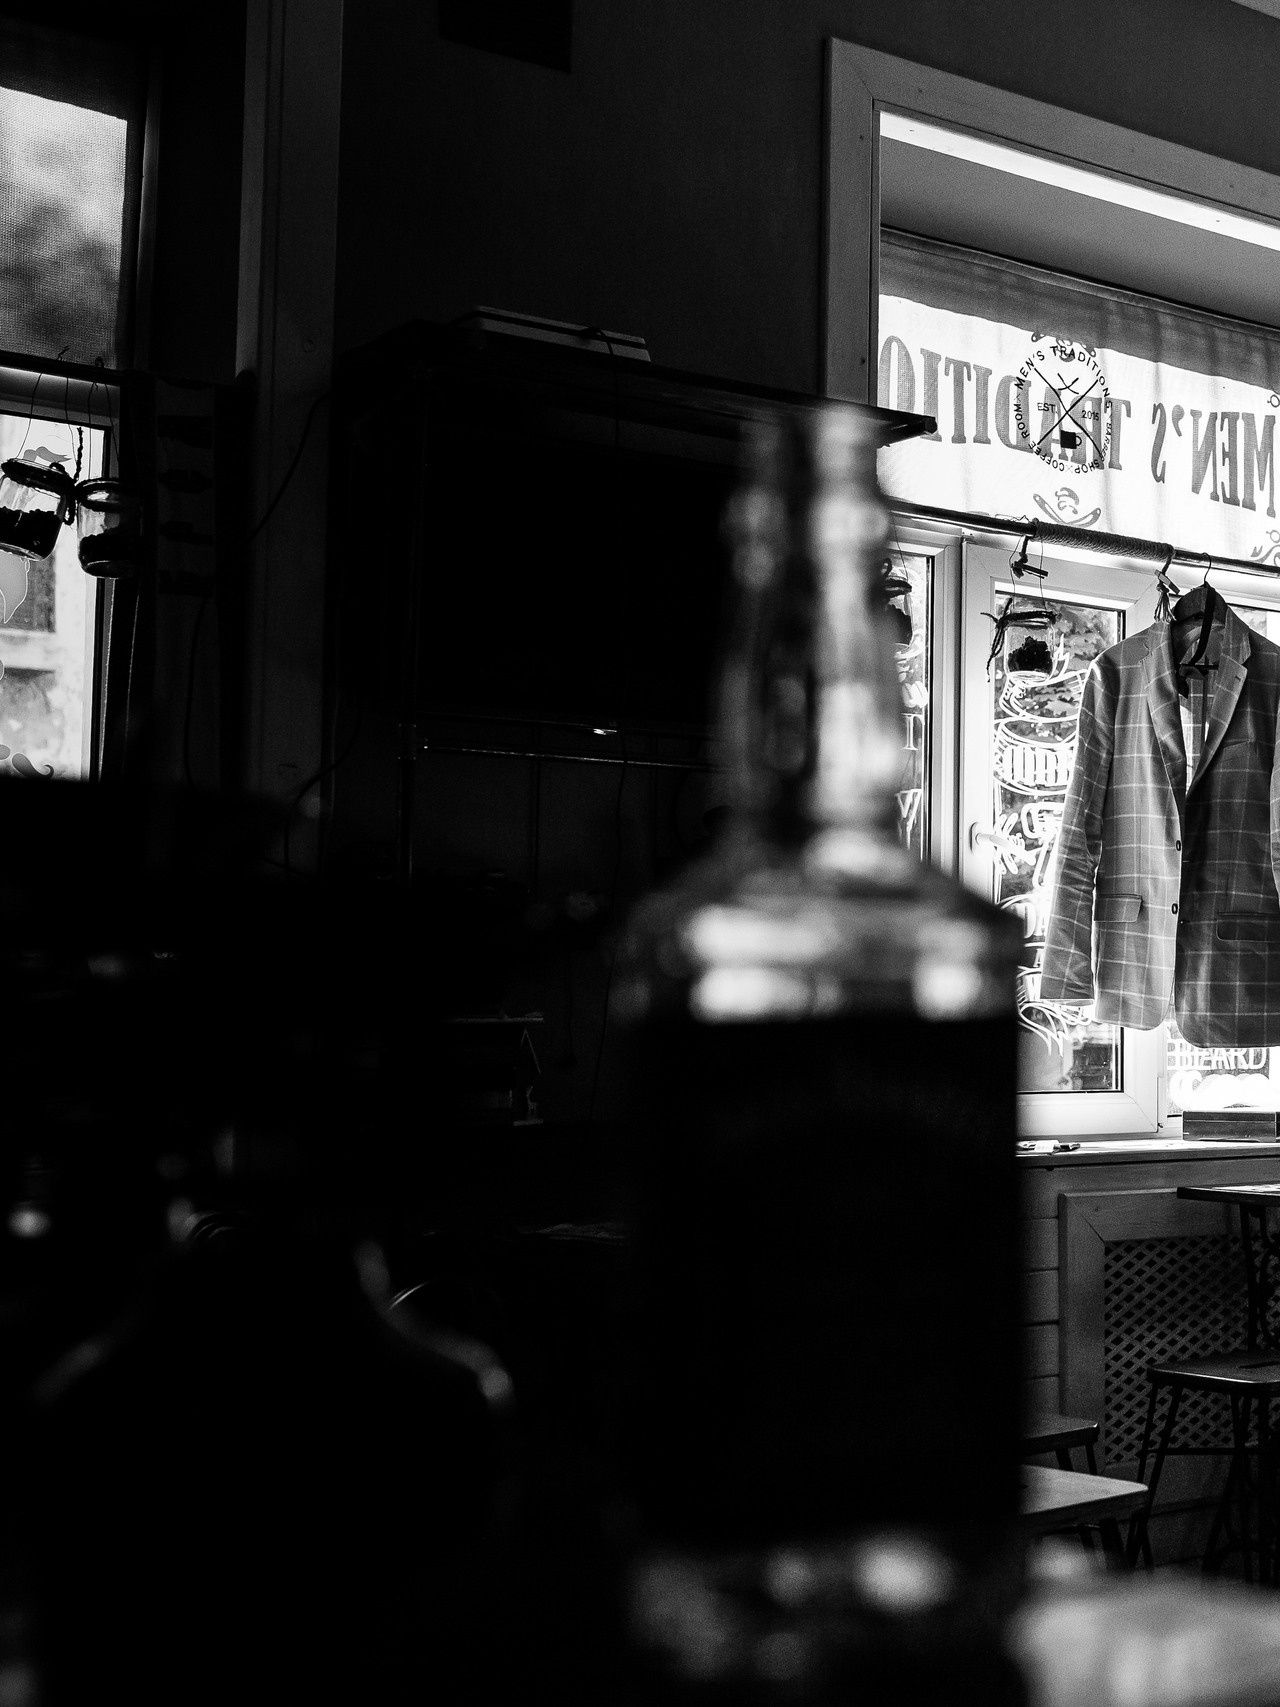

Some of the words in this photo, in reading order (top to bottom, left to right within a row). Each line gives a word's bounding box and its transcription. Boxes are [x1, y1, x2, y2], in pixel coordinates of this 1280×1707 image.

[1013, 350, 1046, 390] MEN'S
[1013, 403, 1030, 439] ROOM
[1081, 410, 1100, 422] 2015
[1028, 440, 1065, 472] COFFEE
[1074, 459, 1101, 474] SHOP
